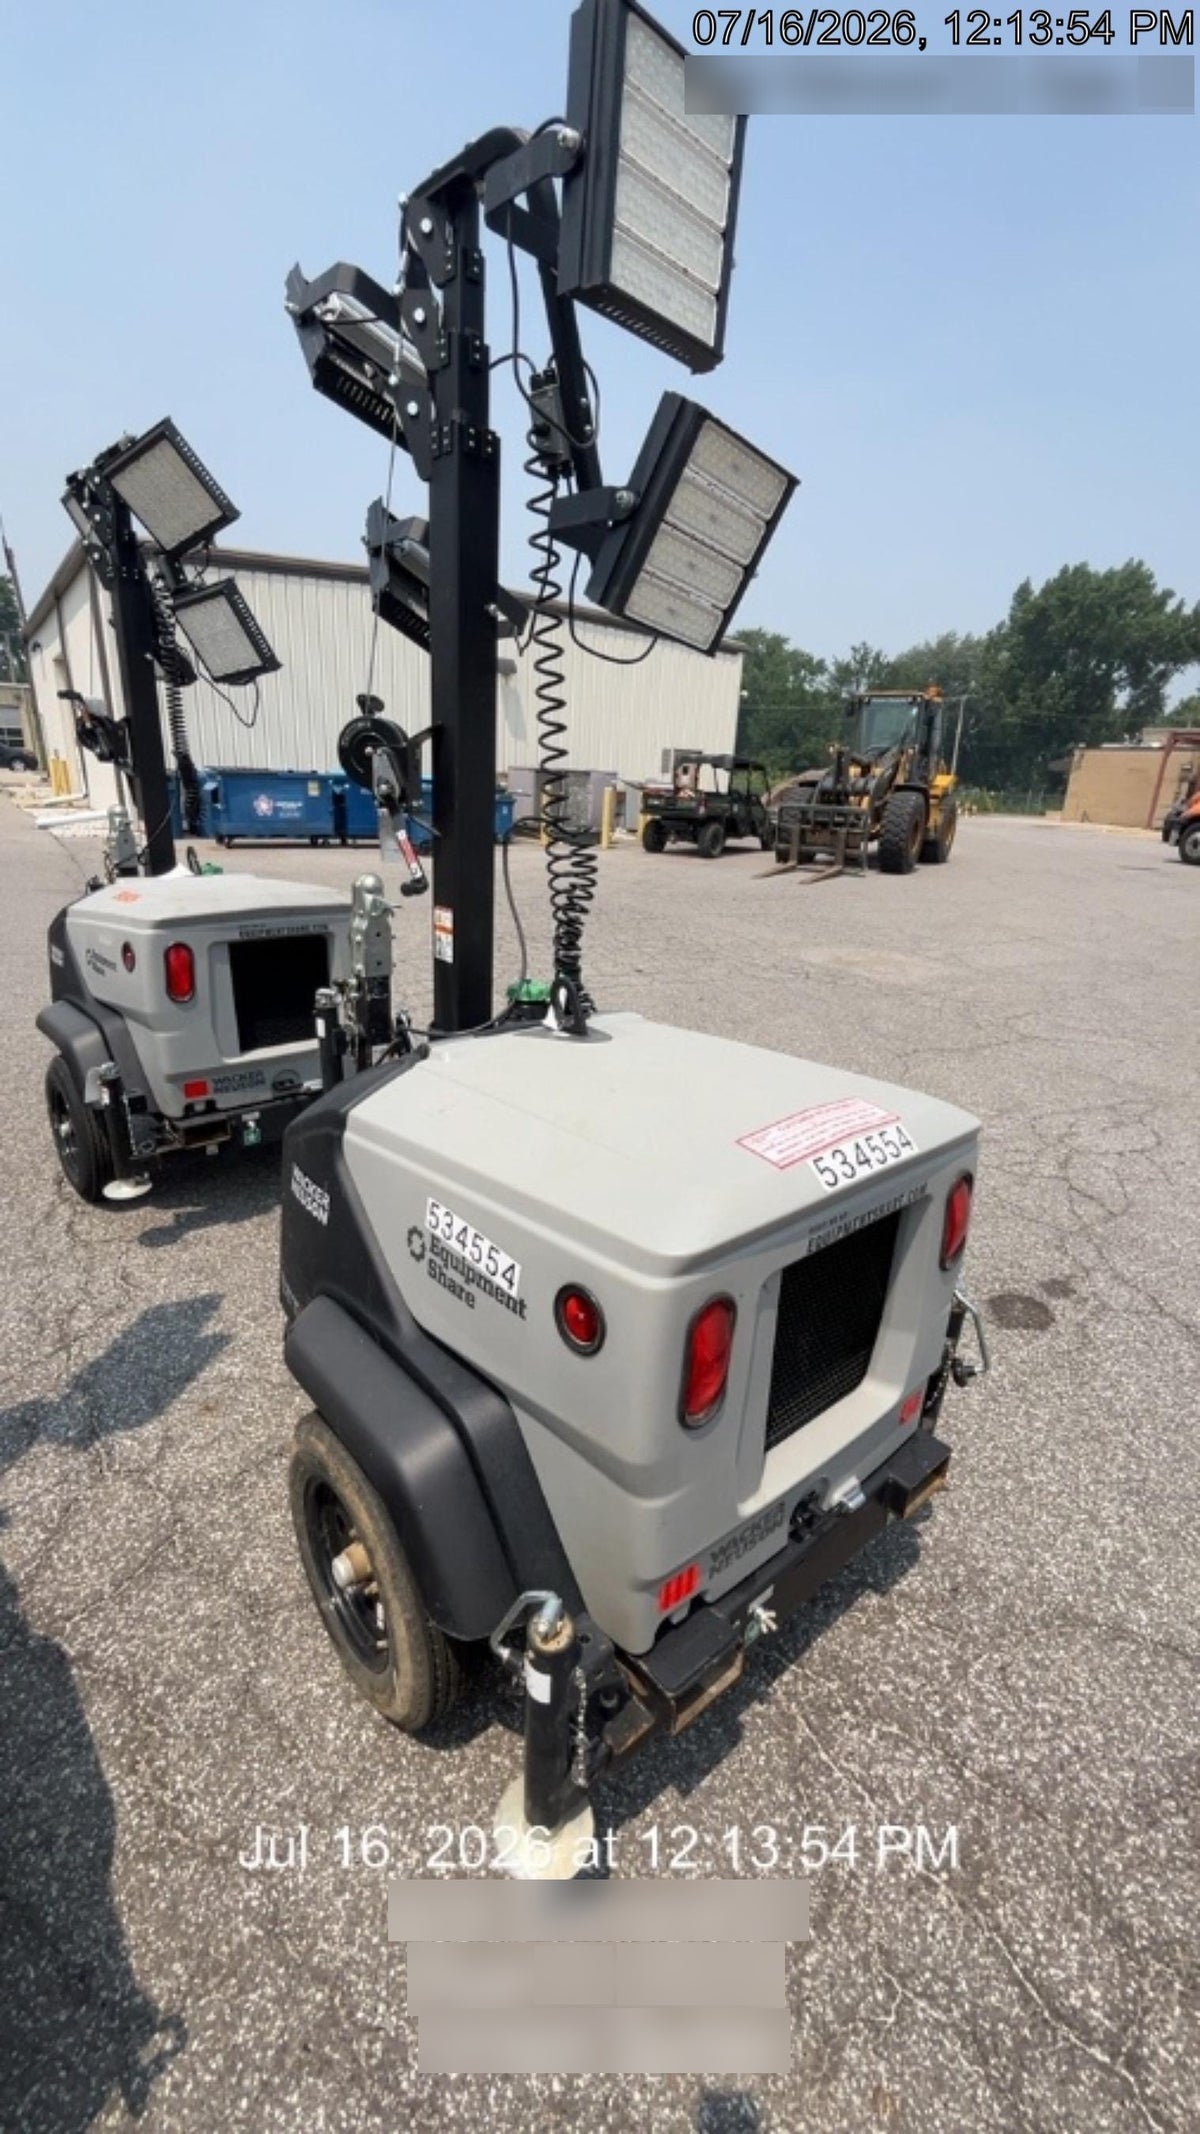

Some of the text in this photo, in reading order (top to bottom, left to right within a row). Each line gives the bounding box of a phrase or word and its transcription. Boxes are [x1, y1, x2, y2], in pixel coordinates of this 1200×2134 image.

[813, 1125, 914, 1188] 534554
[427, 1201, 517, 1291] 534554
[427, 1258, 476, 1309] Share
[429, 1234, 528, 1321] Equipment
